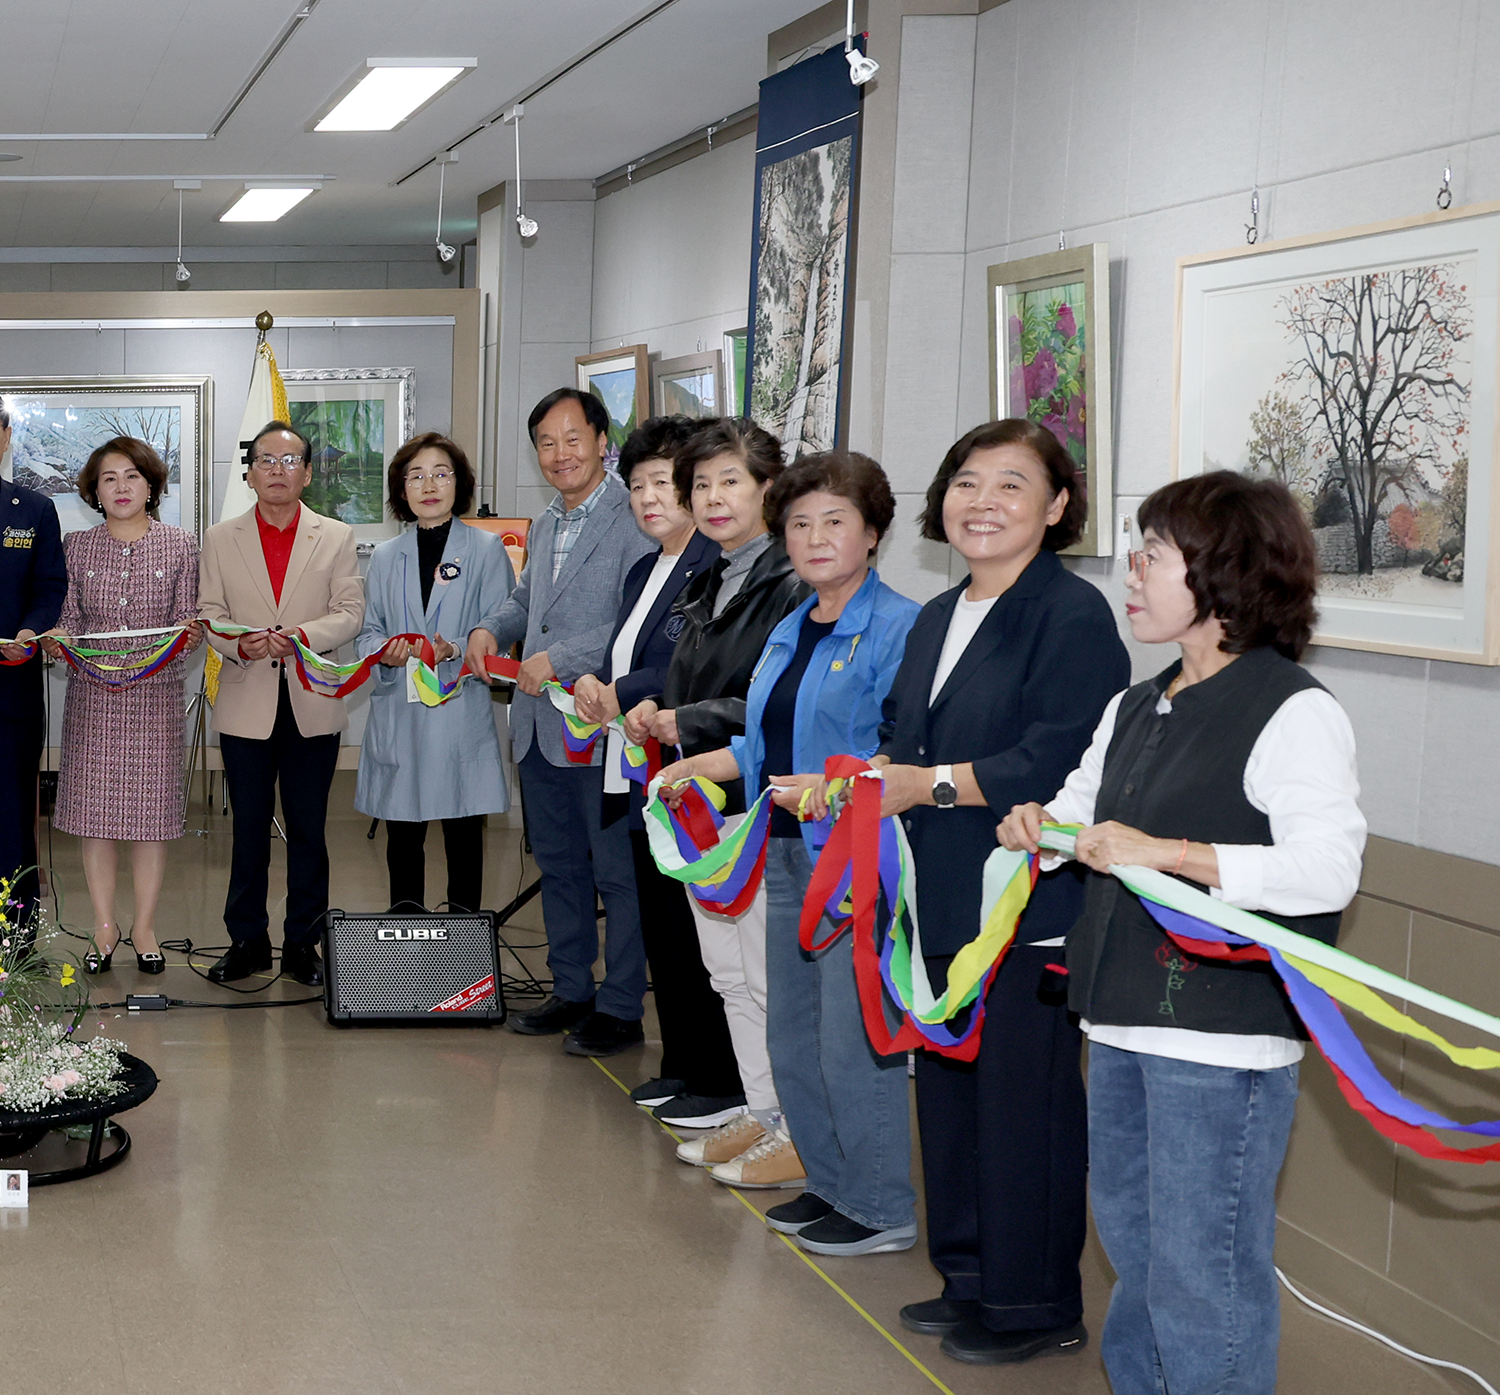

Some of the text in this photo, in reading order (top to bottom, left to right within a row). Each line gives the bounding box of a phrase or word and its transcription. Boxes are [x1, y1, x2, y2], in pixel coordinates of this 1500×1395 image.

[377, 929, 448, 940] CUBE
[468, 980, 493, 1001] Street
[440, 994, 463, 1010] Roland
